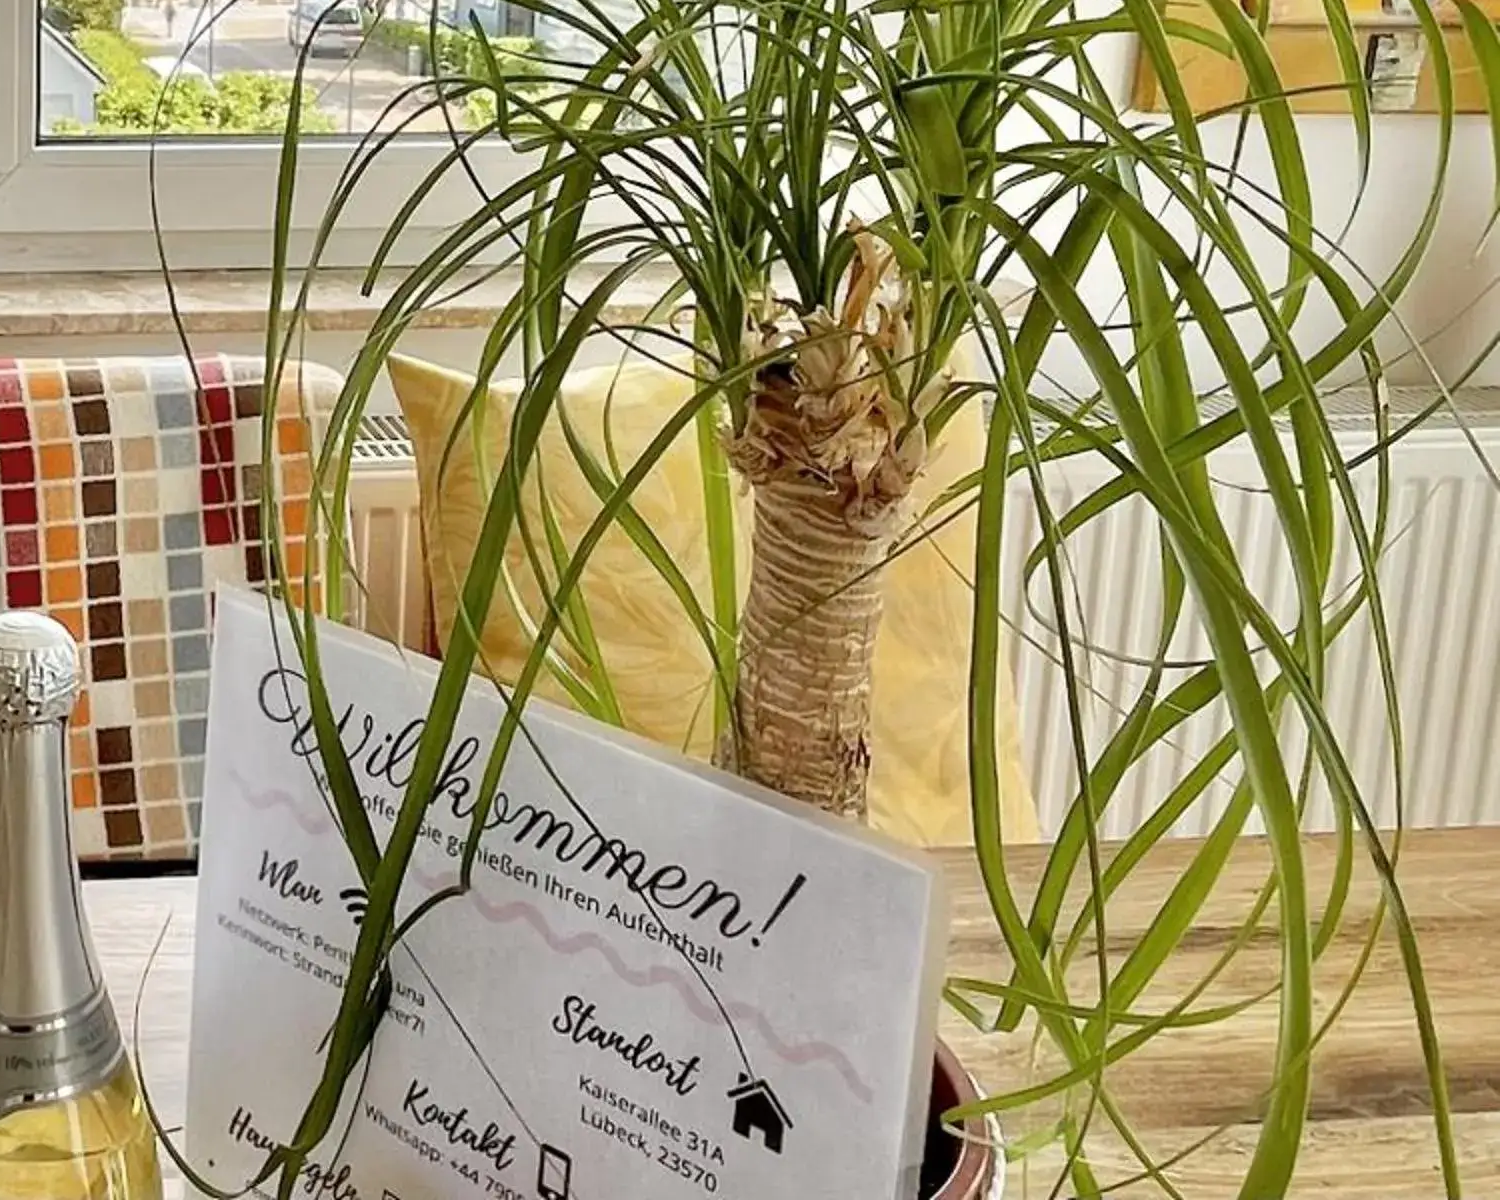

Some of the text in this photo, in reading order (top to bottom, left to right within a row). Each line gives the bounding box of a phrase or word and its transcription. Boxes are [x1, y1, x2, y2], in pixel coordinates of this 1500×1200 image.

[258, 668, 807, 947] Wilkommen!
[258, 850, 324, 904] Wlan
[545, 873, 600, 915] Ihren
[606, 902, 725, 973] Aufenthalt
[552, 995, 701, 1096] Standort
[403, 1079, 516, 1171] Kontakt
[578, 1074, 725, 1166] Kaiserallee 31A
[580, 1104, 718, 1193] Lübeck, 23570
